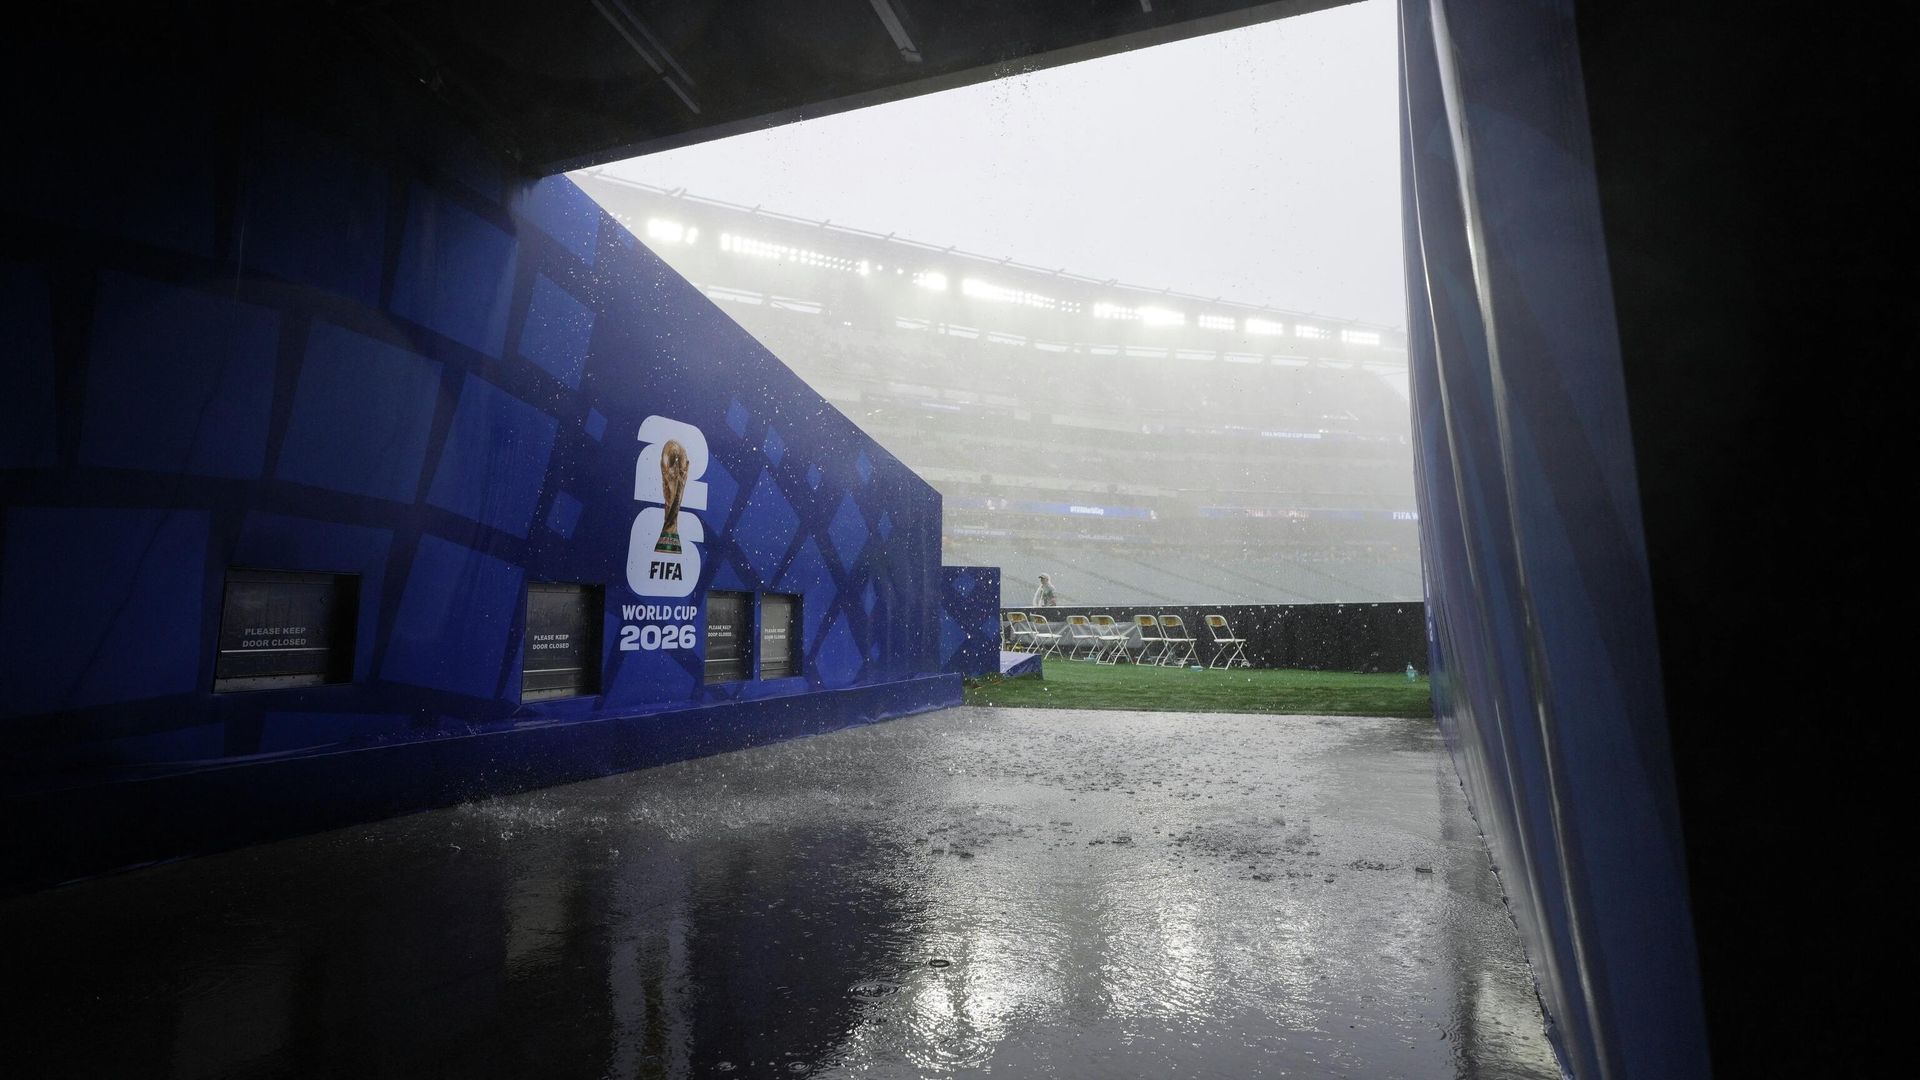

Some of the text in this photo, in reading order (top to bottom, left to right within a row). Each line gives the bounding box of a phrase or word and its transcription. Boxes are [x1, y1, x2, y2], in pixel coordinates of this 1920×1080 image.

[1393, 511, 1411, 520] FIFA
[649, 561, 683, 581] FIFA
[622, 605, 697, 620] WORLD CUP
[283, 627, 306, 635] KEEP
[242, 640, 269, 648] DOOR
[620, 625, 696, 651] 2026
